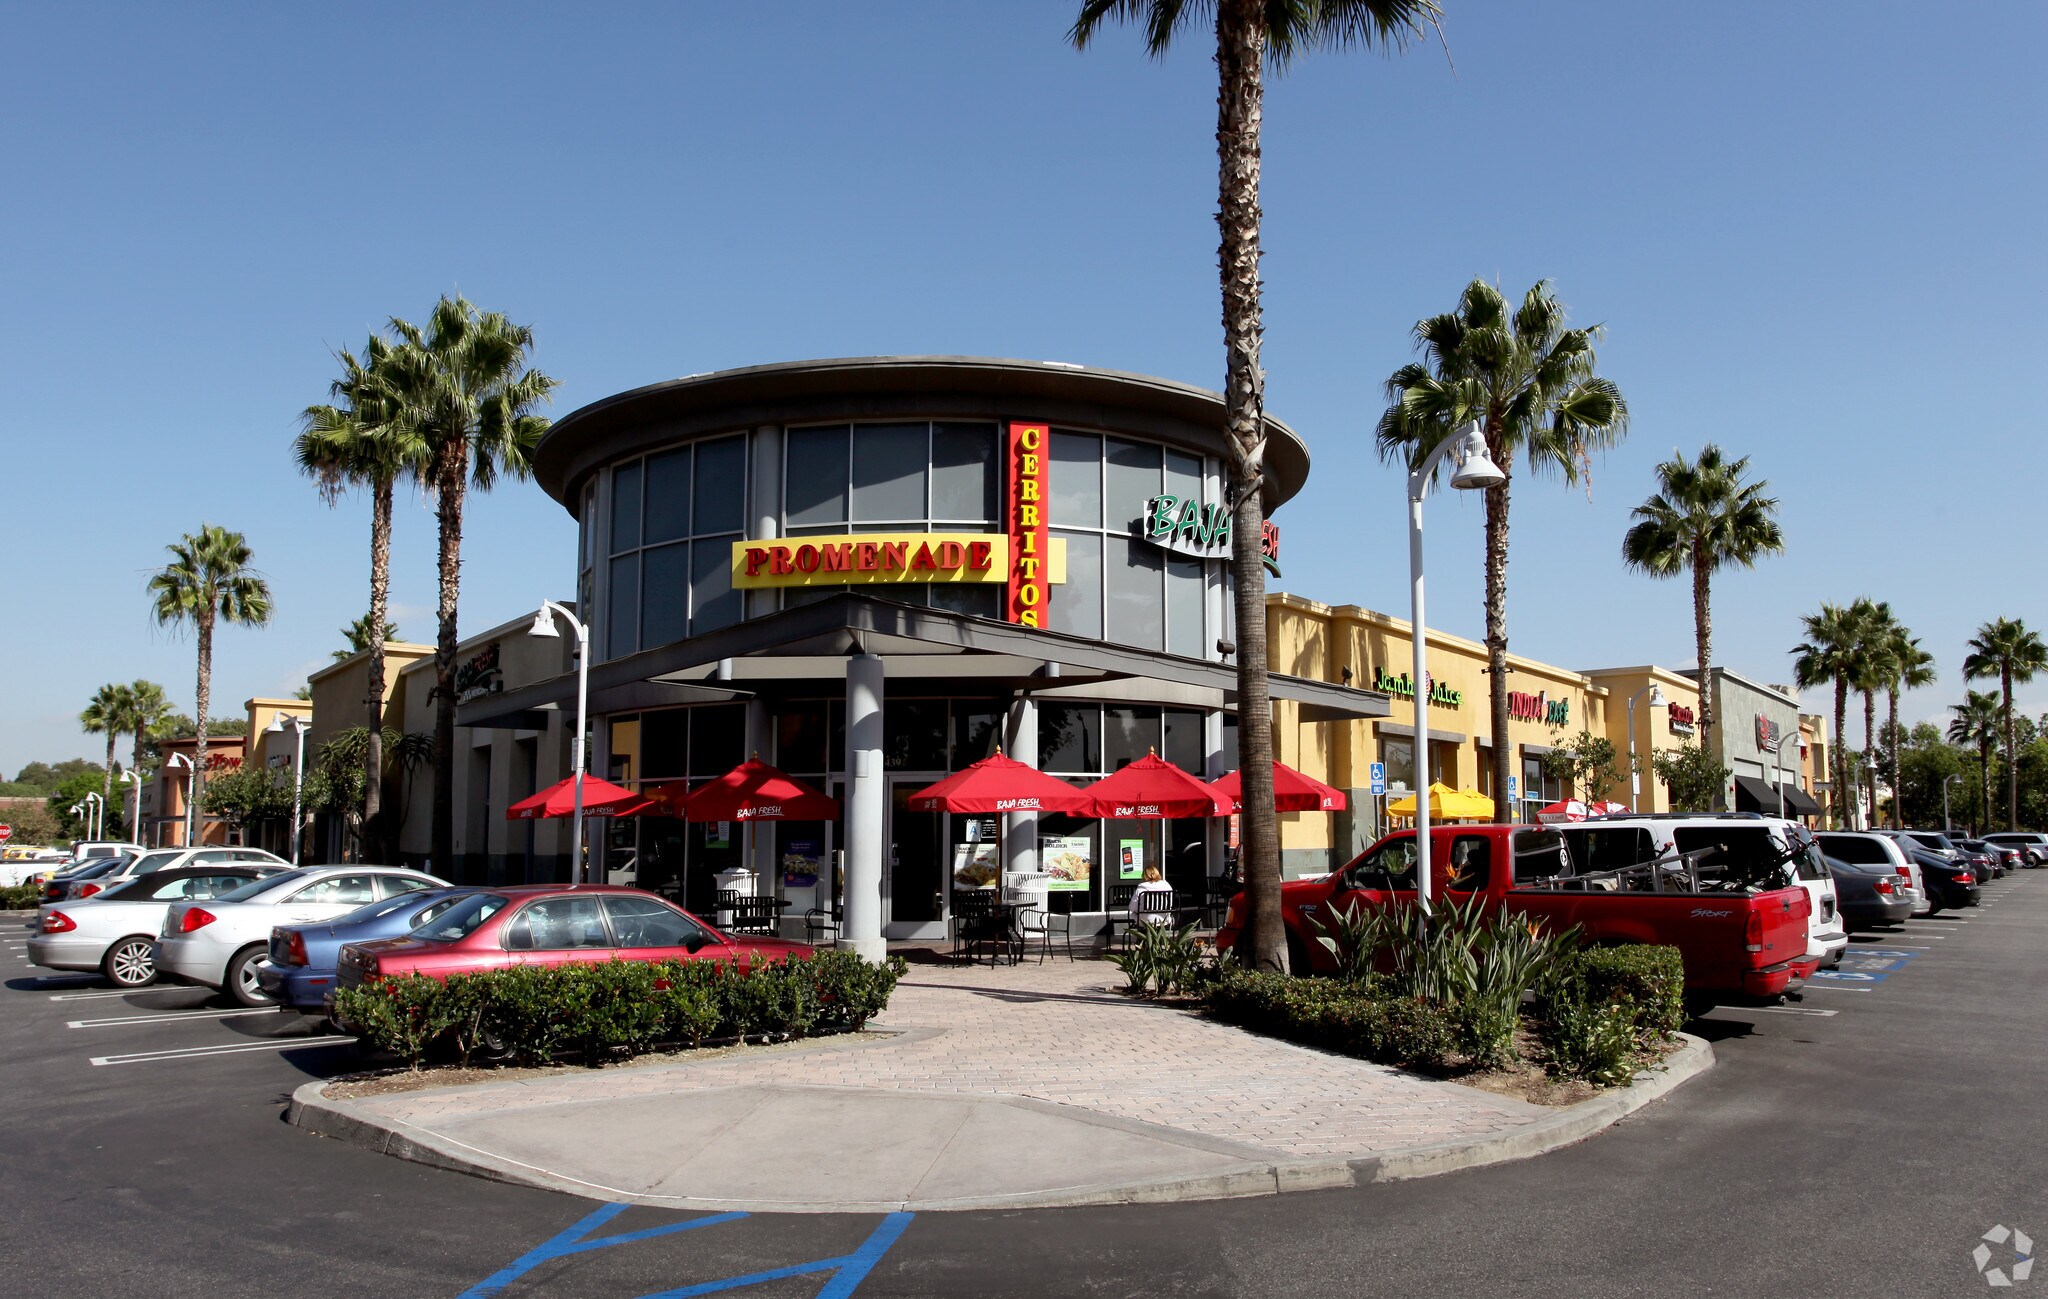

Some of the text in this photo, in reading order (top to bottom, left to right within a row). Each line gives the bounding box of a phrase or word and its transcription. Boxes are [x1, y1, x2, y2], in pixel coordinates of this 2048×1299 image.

[1020, 428, 1041, 629] CERRITOS
[1152, 494, 1232, 546] BAJA
[744, 540, 993, 577] PROMENADE
[1378, 667, 1464, 705] Jamb Juice
[1511, 690, 1541, 719] INDIA
[596, 806, 616, 815] FRESH
[736, 806, 783, 818] BAJA FRESH
[996, 798, 1041, 810] BAJA FRESH
[1115, 805, 1160, 817] BAJA FRESH
[1691, 908, 1733, 918] SPORT
